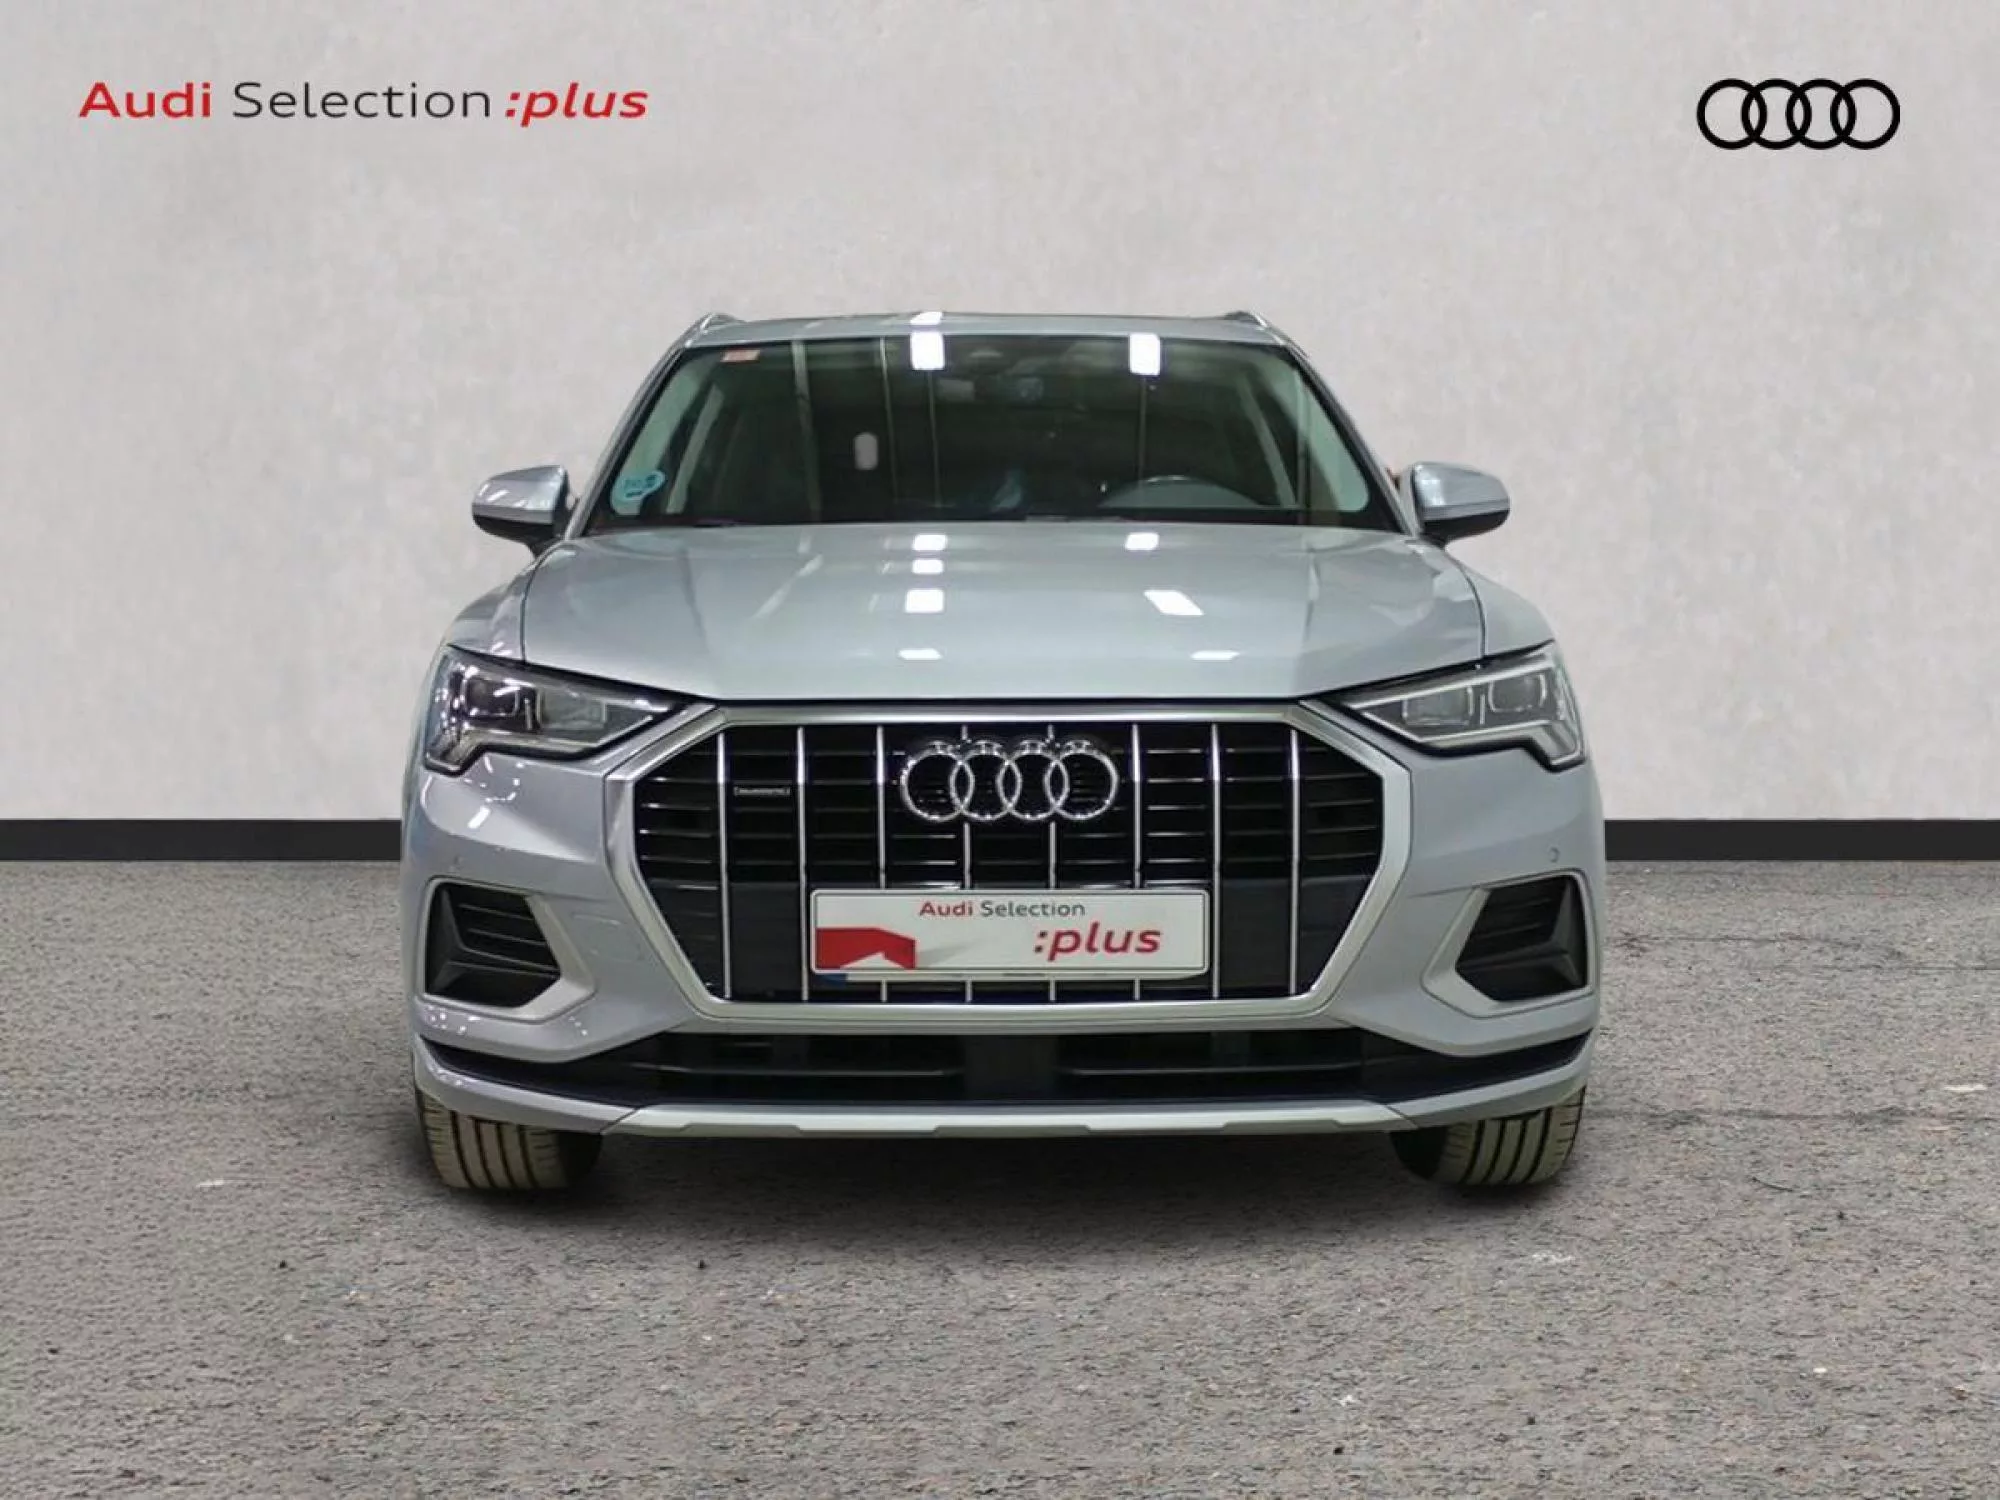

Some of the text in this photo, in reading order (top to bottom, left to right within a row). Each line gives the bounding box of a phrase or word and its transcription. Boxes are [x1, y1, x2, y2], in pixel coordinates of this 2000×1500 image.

[919, 900, 1086, 917] Audi Selection
[1034, 921, 1162, 962] :plus
